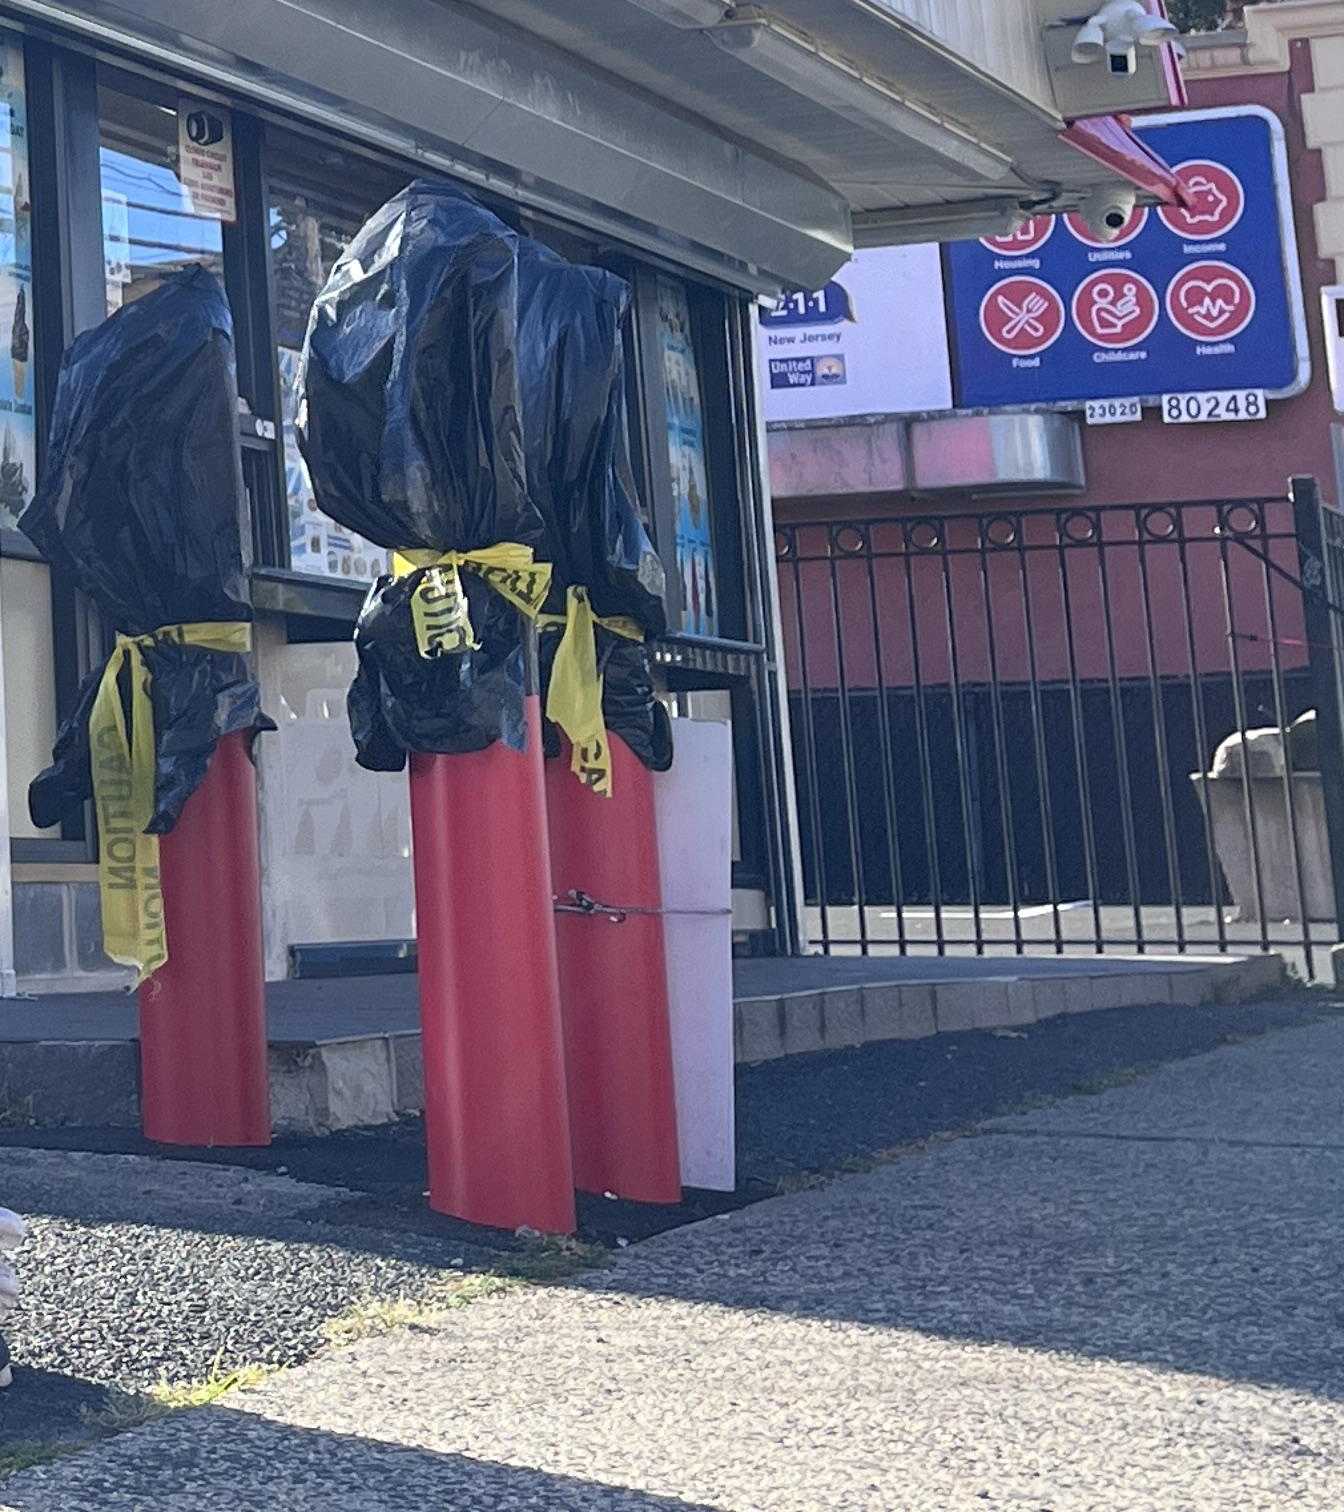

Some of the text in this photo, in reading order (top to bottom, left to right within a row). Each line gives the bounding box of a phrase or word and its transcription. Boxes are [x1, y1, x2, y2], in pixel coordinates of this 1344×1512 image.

[993, 241, 1227, 271] Housing Utilities Income
[767, 331, 843, 347] New Jersey
[1012, 343, 1236, 369] Food Childcare Health
[770, 359, 813, 374] United
[787, 372, 813, 387] Way
[1087, 401, 1139, 419] 23020
[1166, 392, 1261, 421] 80248
